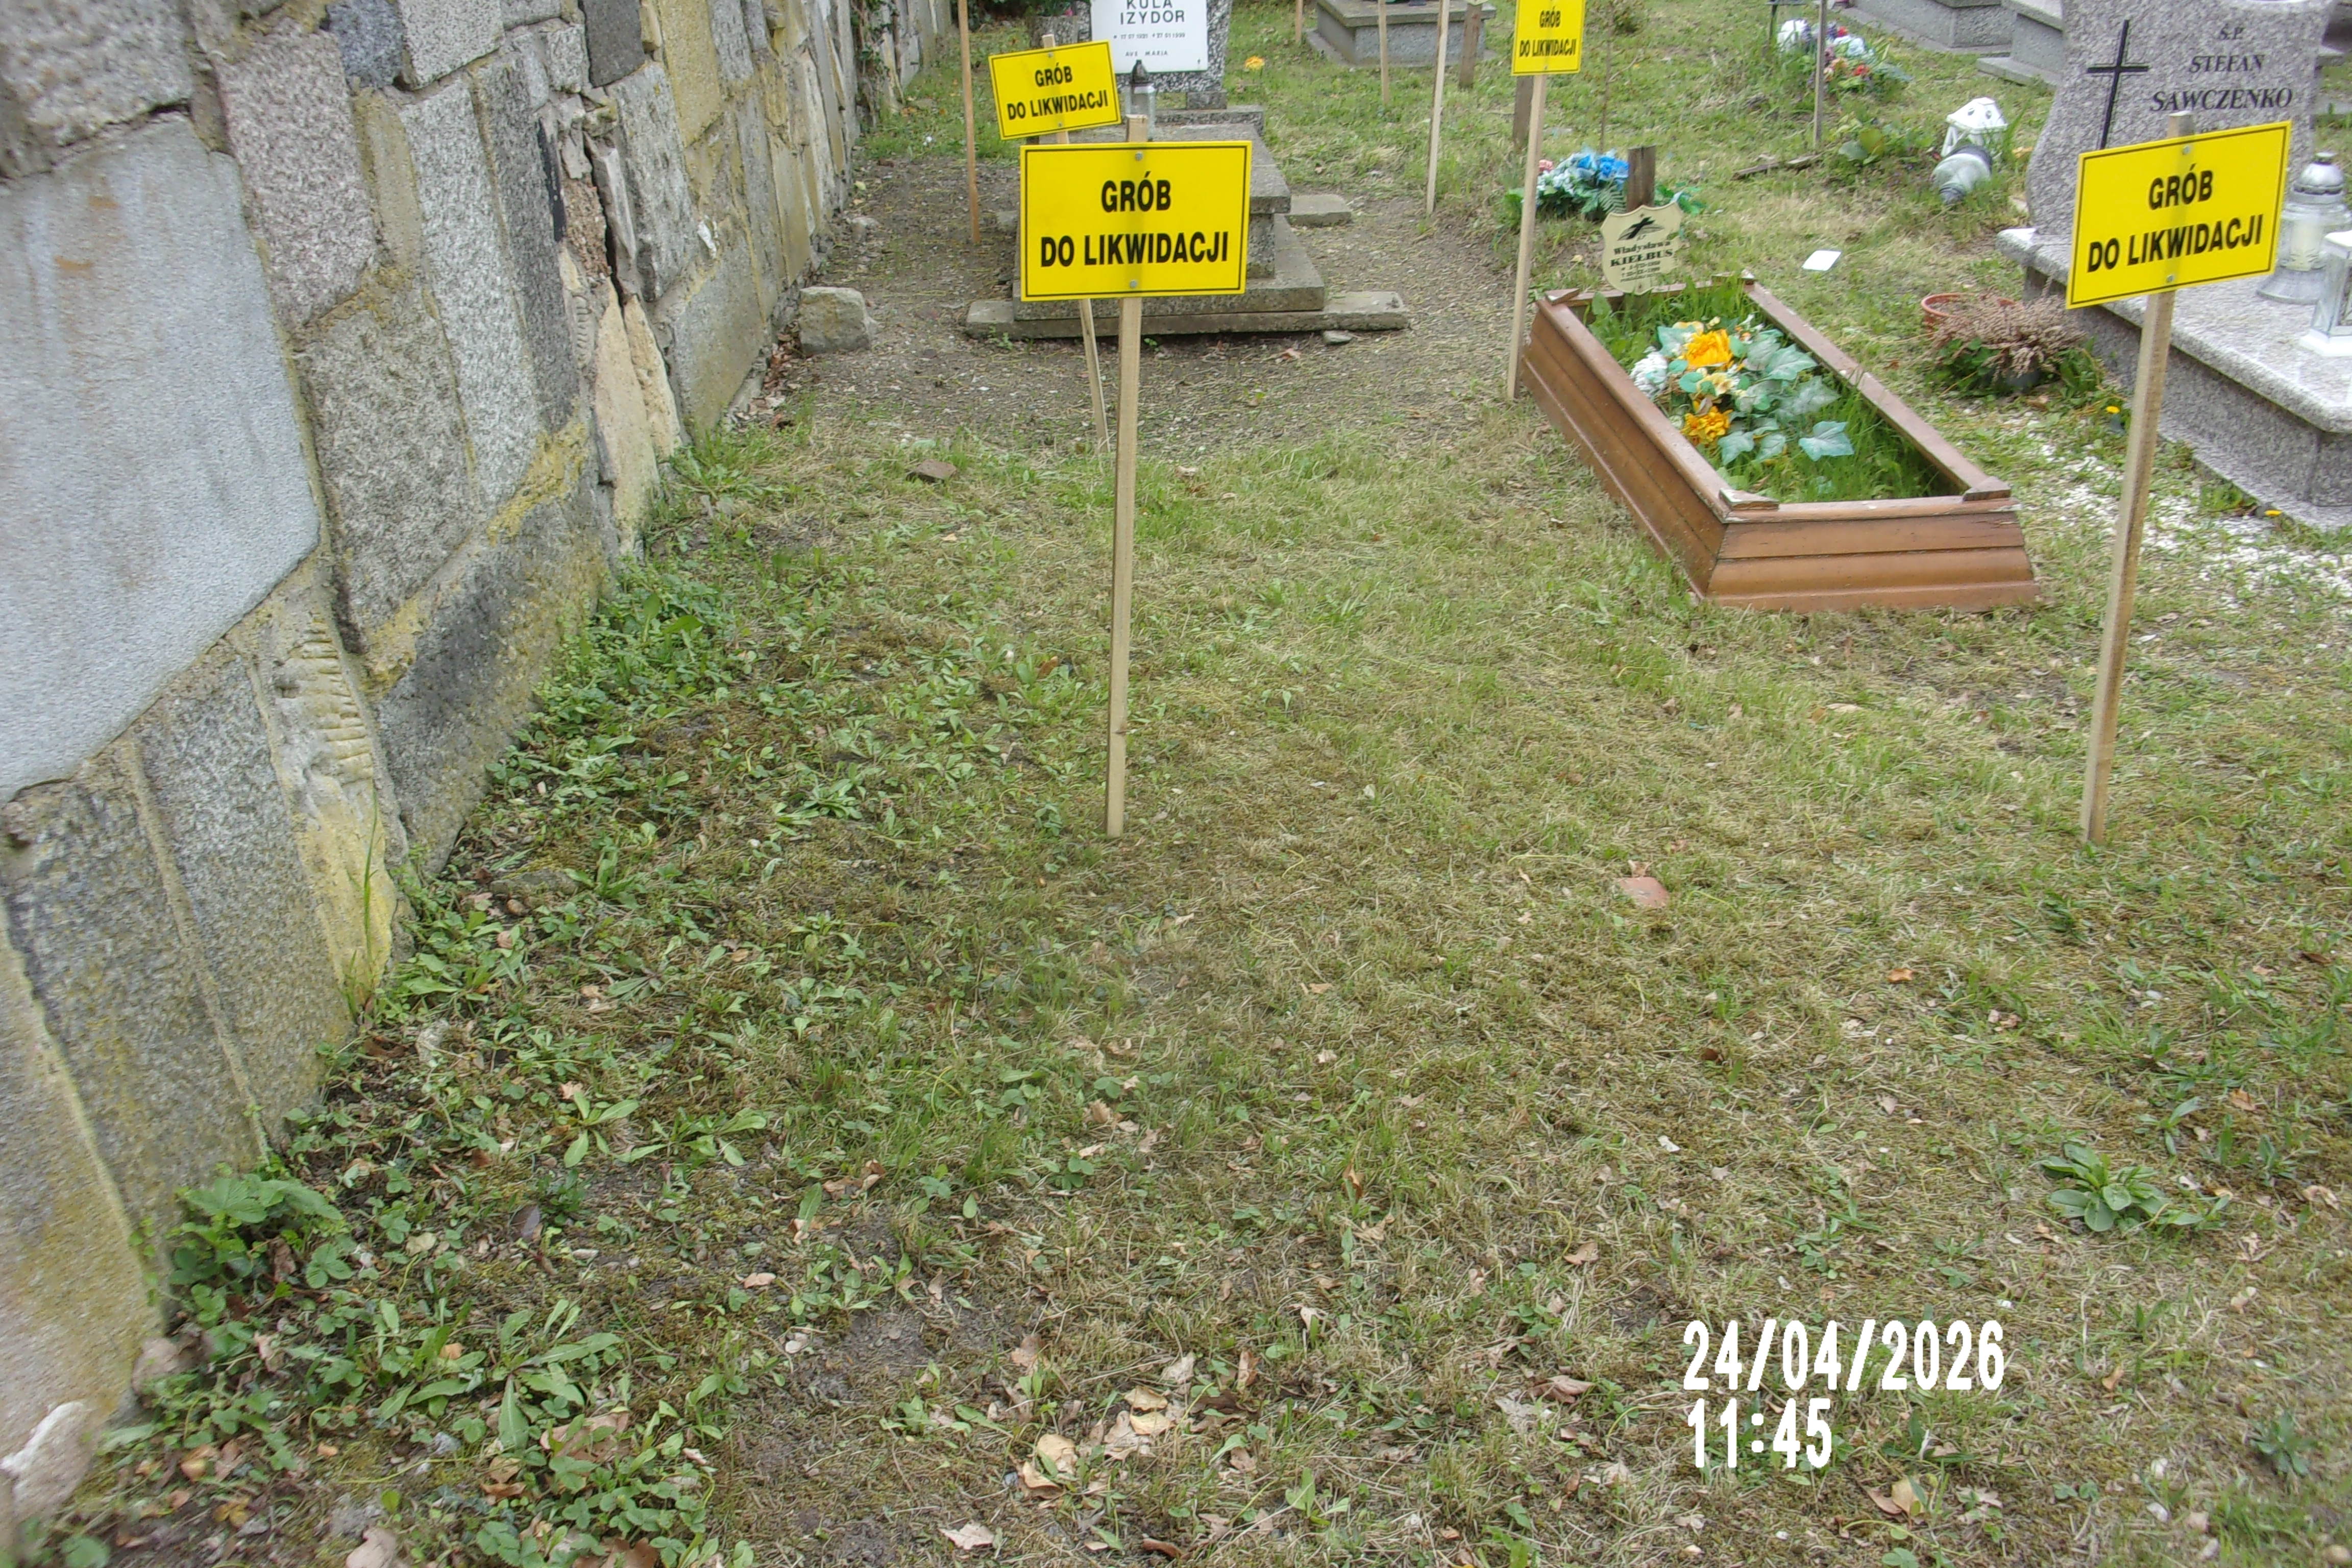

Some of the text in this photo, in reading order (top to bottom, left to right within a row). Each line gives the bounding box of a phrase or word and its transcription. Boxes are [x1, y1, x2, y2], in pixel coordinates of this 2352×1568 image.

[1126, 0, 1172, 10] KULA
[1539, 6, 1561, 28] GRÓB
[1120, 10, 1185, 25] IZYDOR
[1519, 39, 1577, 57] DO LIKWIDACJI
[1035, 62, 1072, 87] GRÓB
[2189, 54, 2265, 73] STEFAN
[1007, 90, 1108, 120] DO LIKWIDACJI
[2149, 87, 2293, 111] SAWCZENKO
[1101, 170, 1171, 213] GRÓB
[2148, 163, 2213, 210] GRÓB
[1040, 231, 1229, 267] DO LIKWIDACJI
[2087, 213, 2264, 273] DO LIKWIDACJI
[1610, 249, 1673, 267] KIEŁBUS
